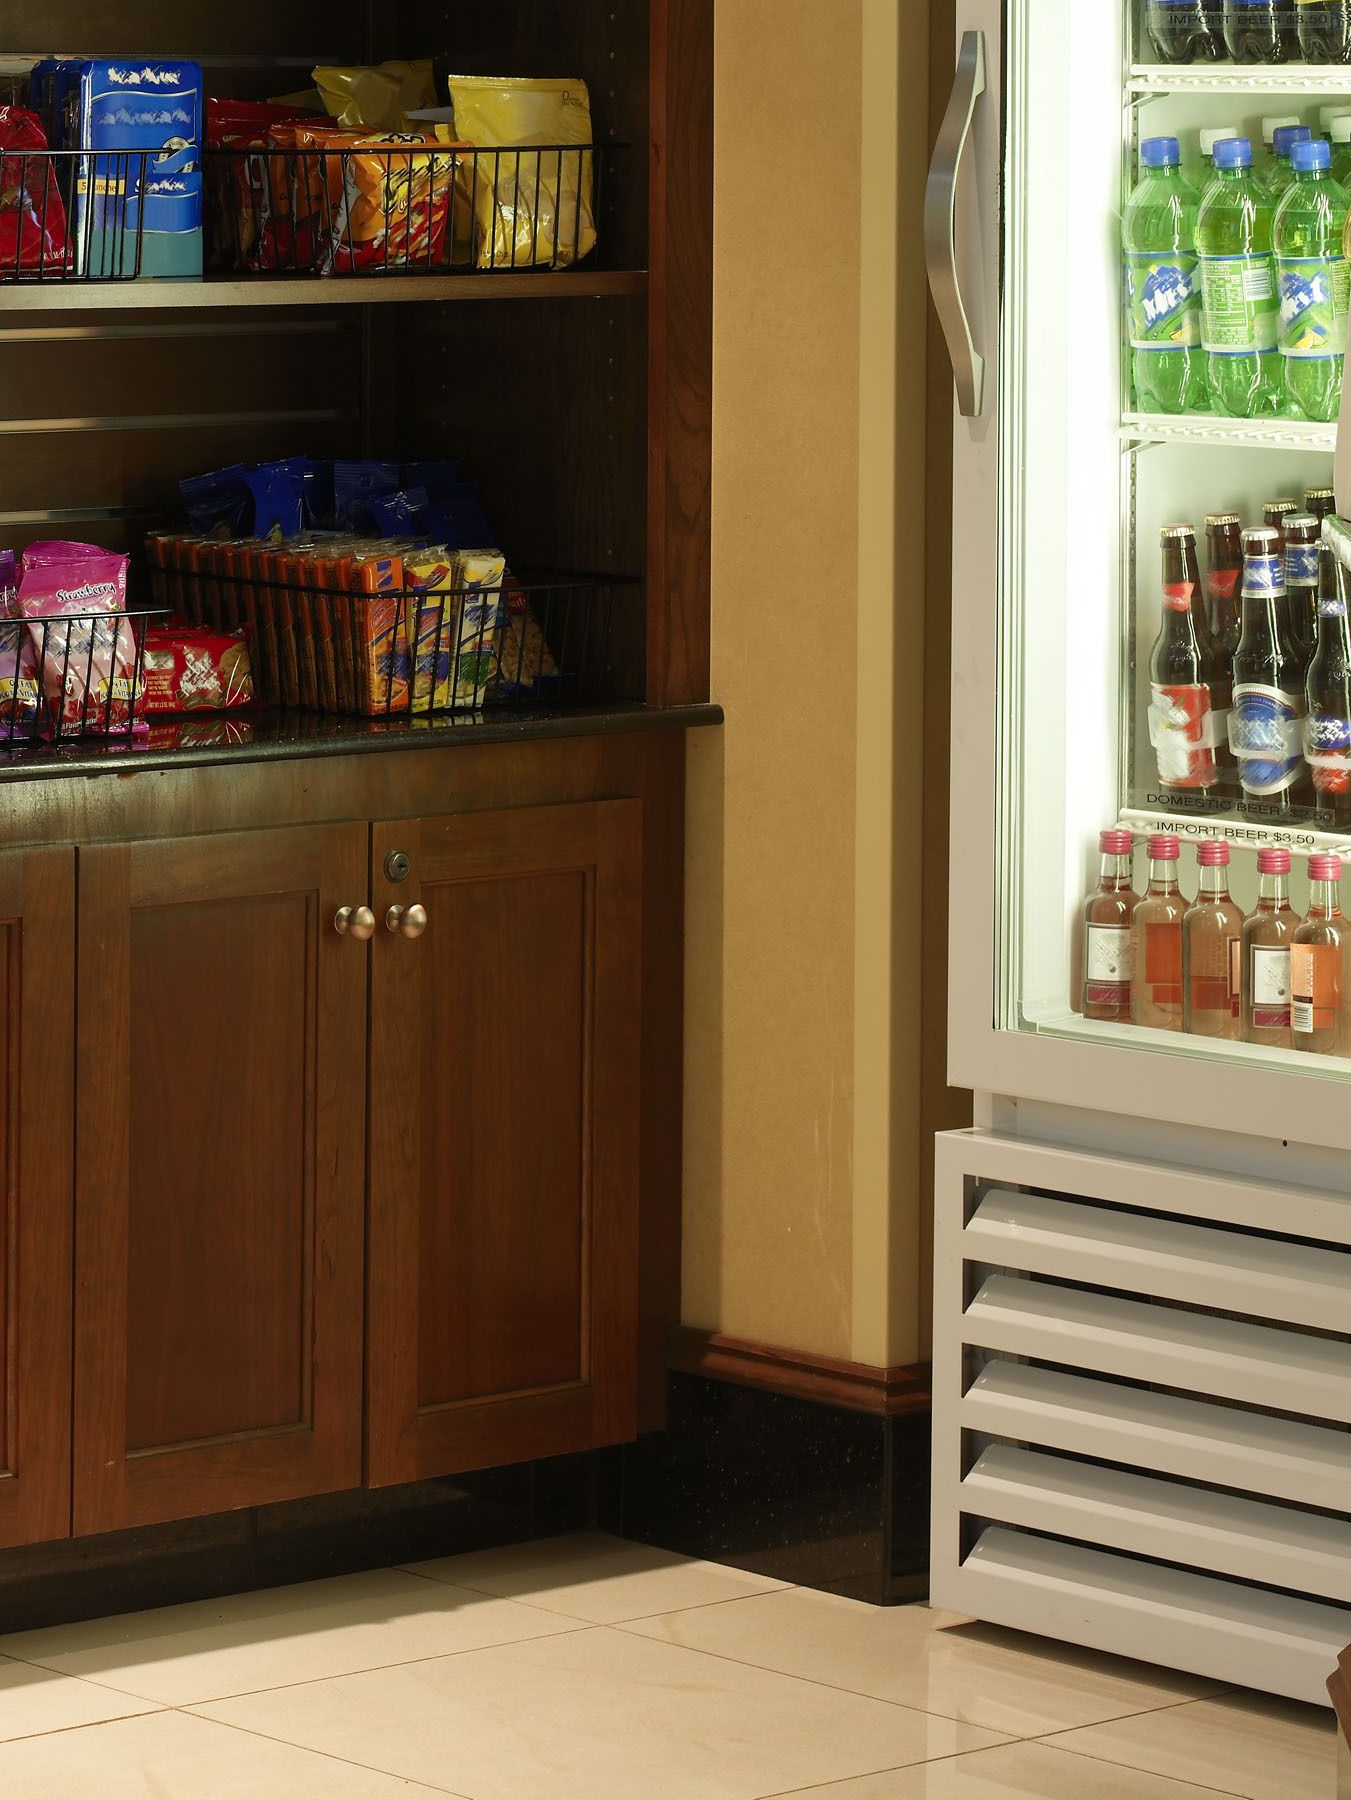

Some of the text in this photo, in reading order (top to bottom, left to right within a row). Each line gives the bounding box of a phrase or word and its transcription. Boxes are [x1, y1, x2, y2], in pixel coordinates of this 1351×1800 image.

[1169, 14, 1230, 25] IMPORT
[1237, 14, 1282, 25] BEER
[56, 582, 116, 604] Strawberry
[1147, 794, 1232, 810] DOMESTIC
[1237, 802, 1280, 816] BEER
[1156, 822, 1315, 845] IMPORT BEER $3.50
